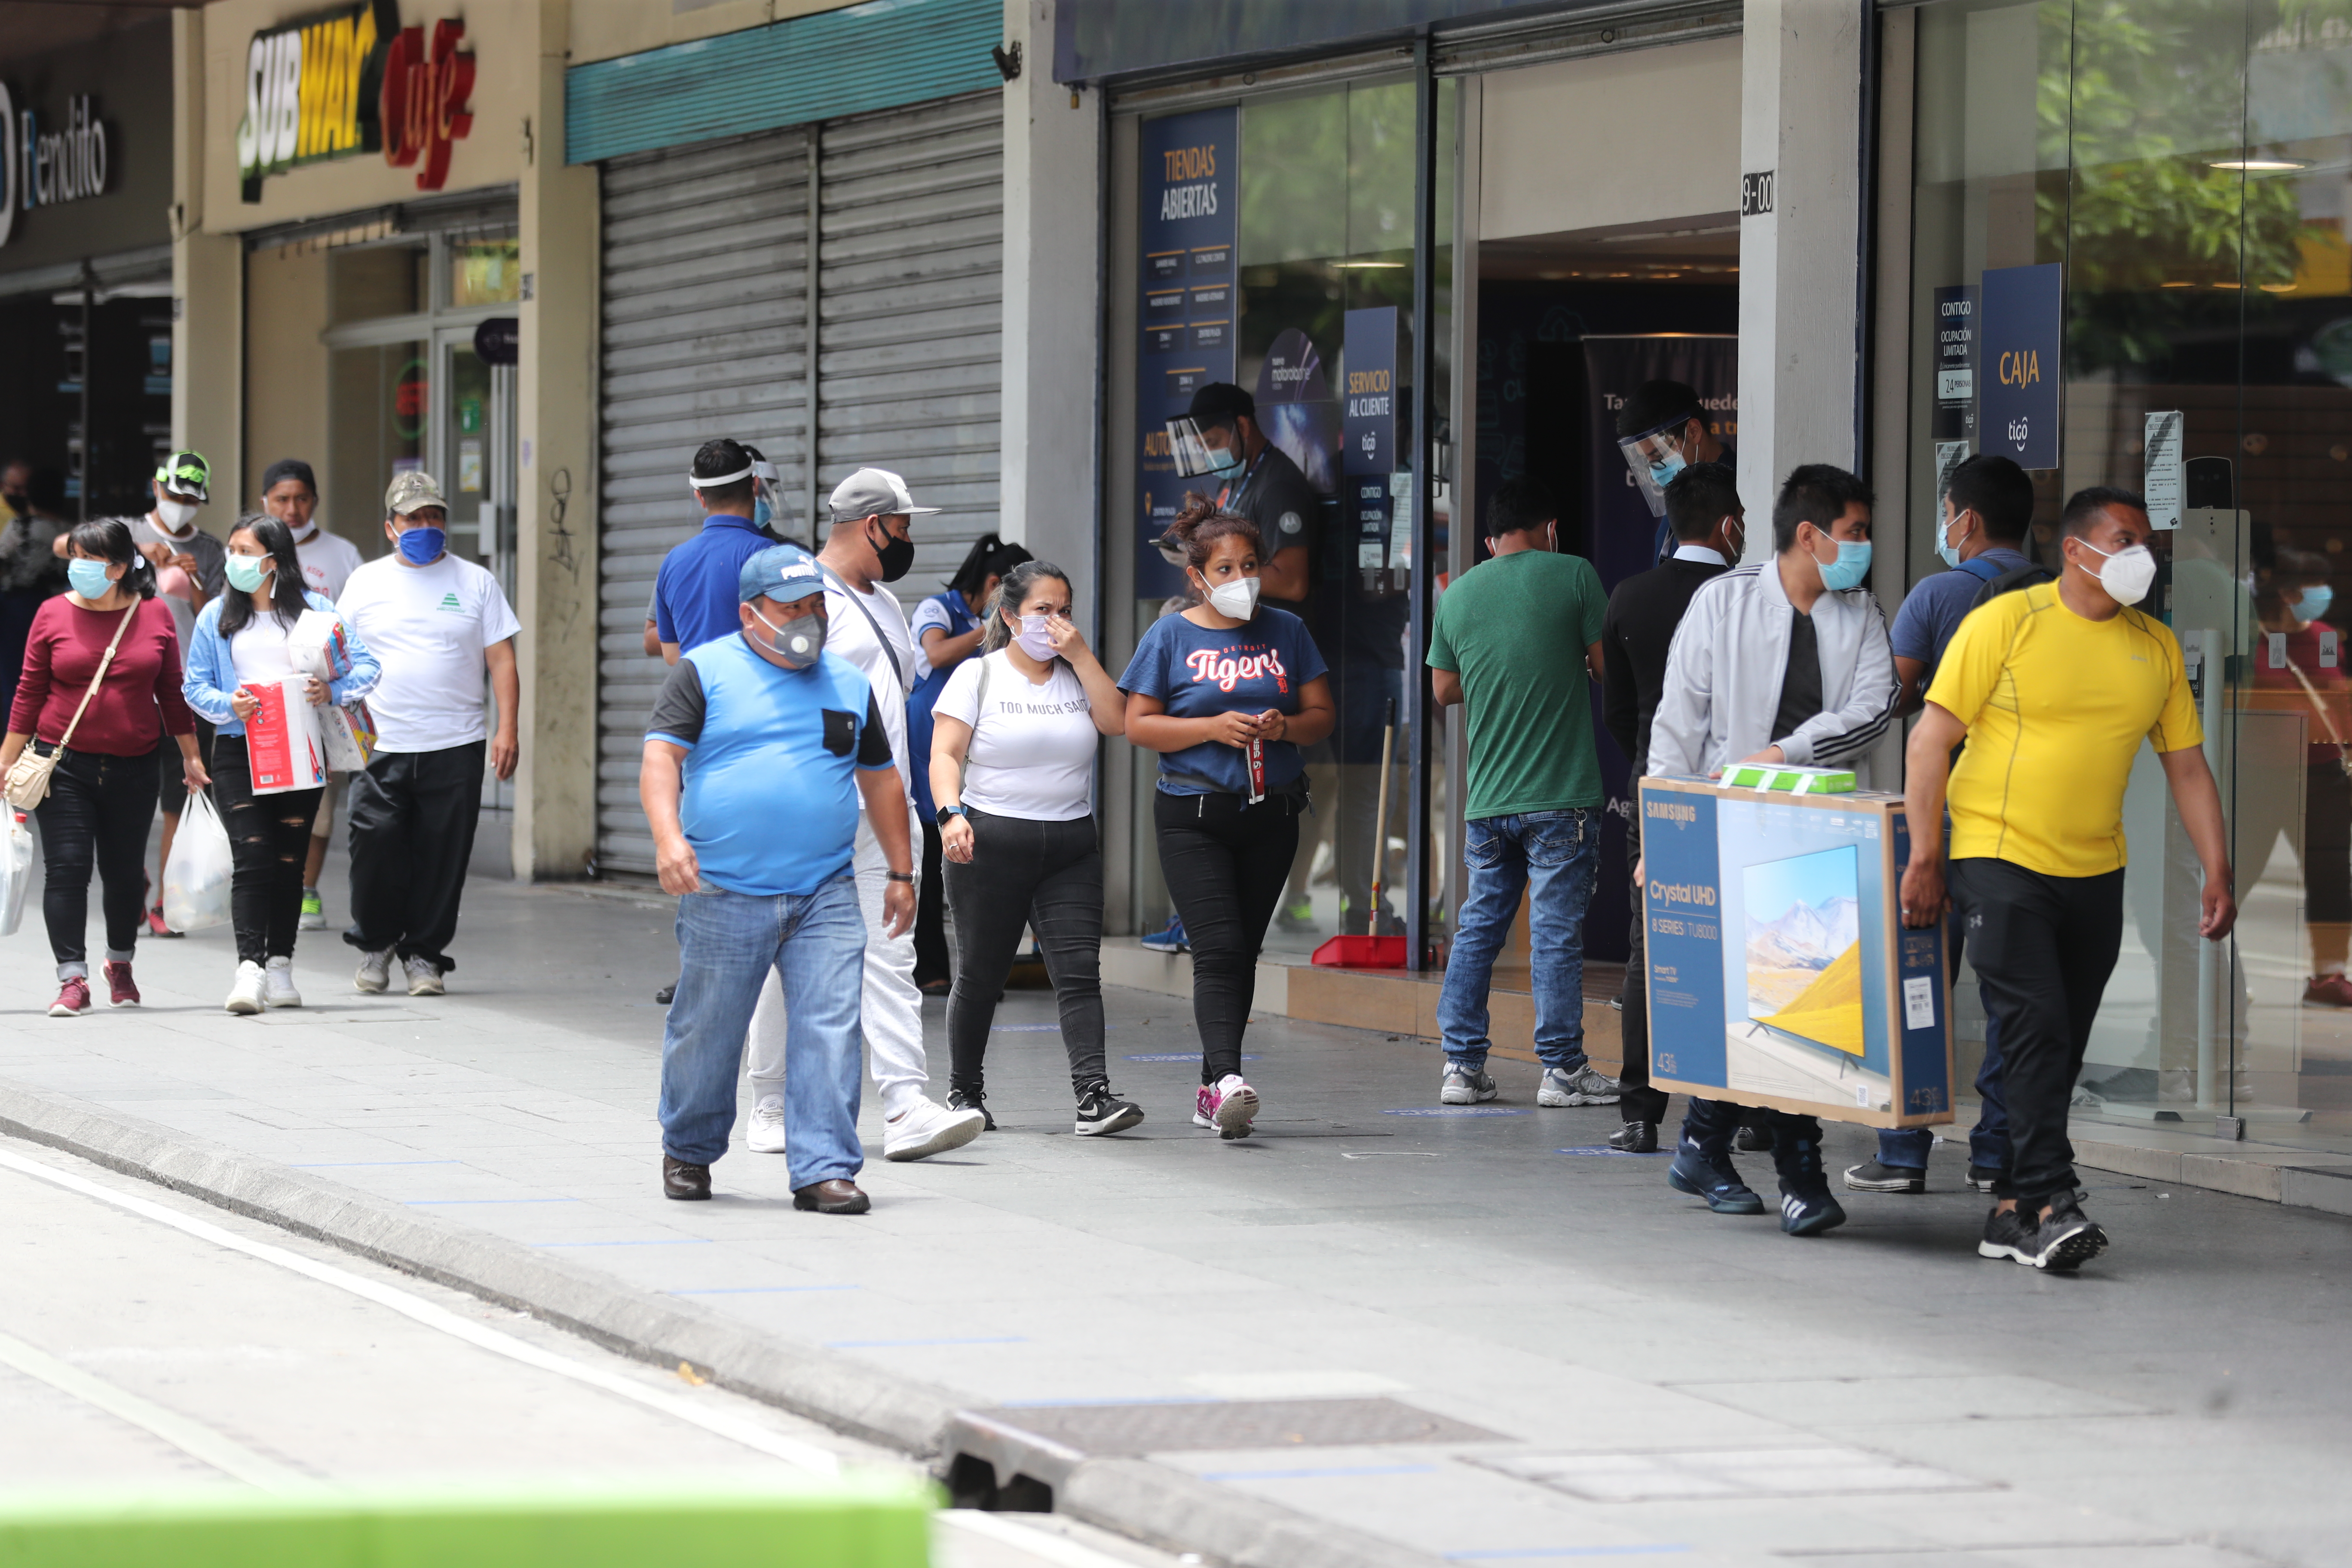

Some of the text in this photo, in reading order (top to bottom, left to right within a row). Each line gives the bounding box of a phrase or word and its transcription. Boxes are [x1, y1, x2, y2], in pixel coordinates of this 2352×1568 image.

[237, 3, 377, 168] SUBWAY
[21, 94, 106, 211] Bendito
[1164, 144, 1216, 182] TIENDAS
[1161, 182, 1218, 220] ABIERTAS
[1743, 175, 1772, 212] 9-00
[1942, 301, 1971, 316] CONTIGO
[1941, 327, 1972, 343] OCUPACIÓN
[1944, 344, 1967, 356] LIMITADA
[1999, 350, 2040, 389] CAJA
[1349, 369, 1390, 395] SERVICIO
[1946, 379, 1954, 393] 24
[1349, 396, 1390, 418] AL CLIENTE
[1361, 486, 1382, 499] CONTIGO
[1223, 644, 1266, 654] DETROIT
[1186, 649, 1286, 692] Tigers
[999, 701, 1023, 714] TOO
[1027, 703, 1064, 715] MUCH
[1647, 801, 1696, 822] SAMSUNG
[1650, 880, 1716, 907] Crystal UHD
[1652, 918, 1717, 940] 8 SERIES TU8000
